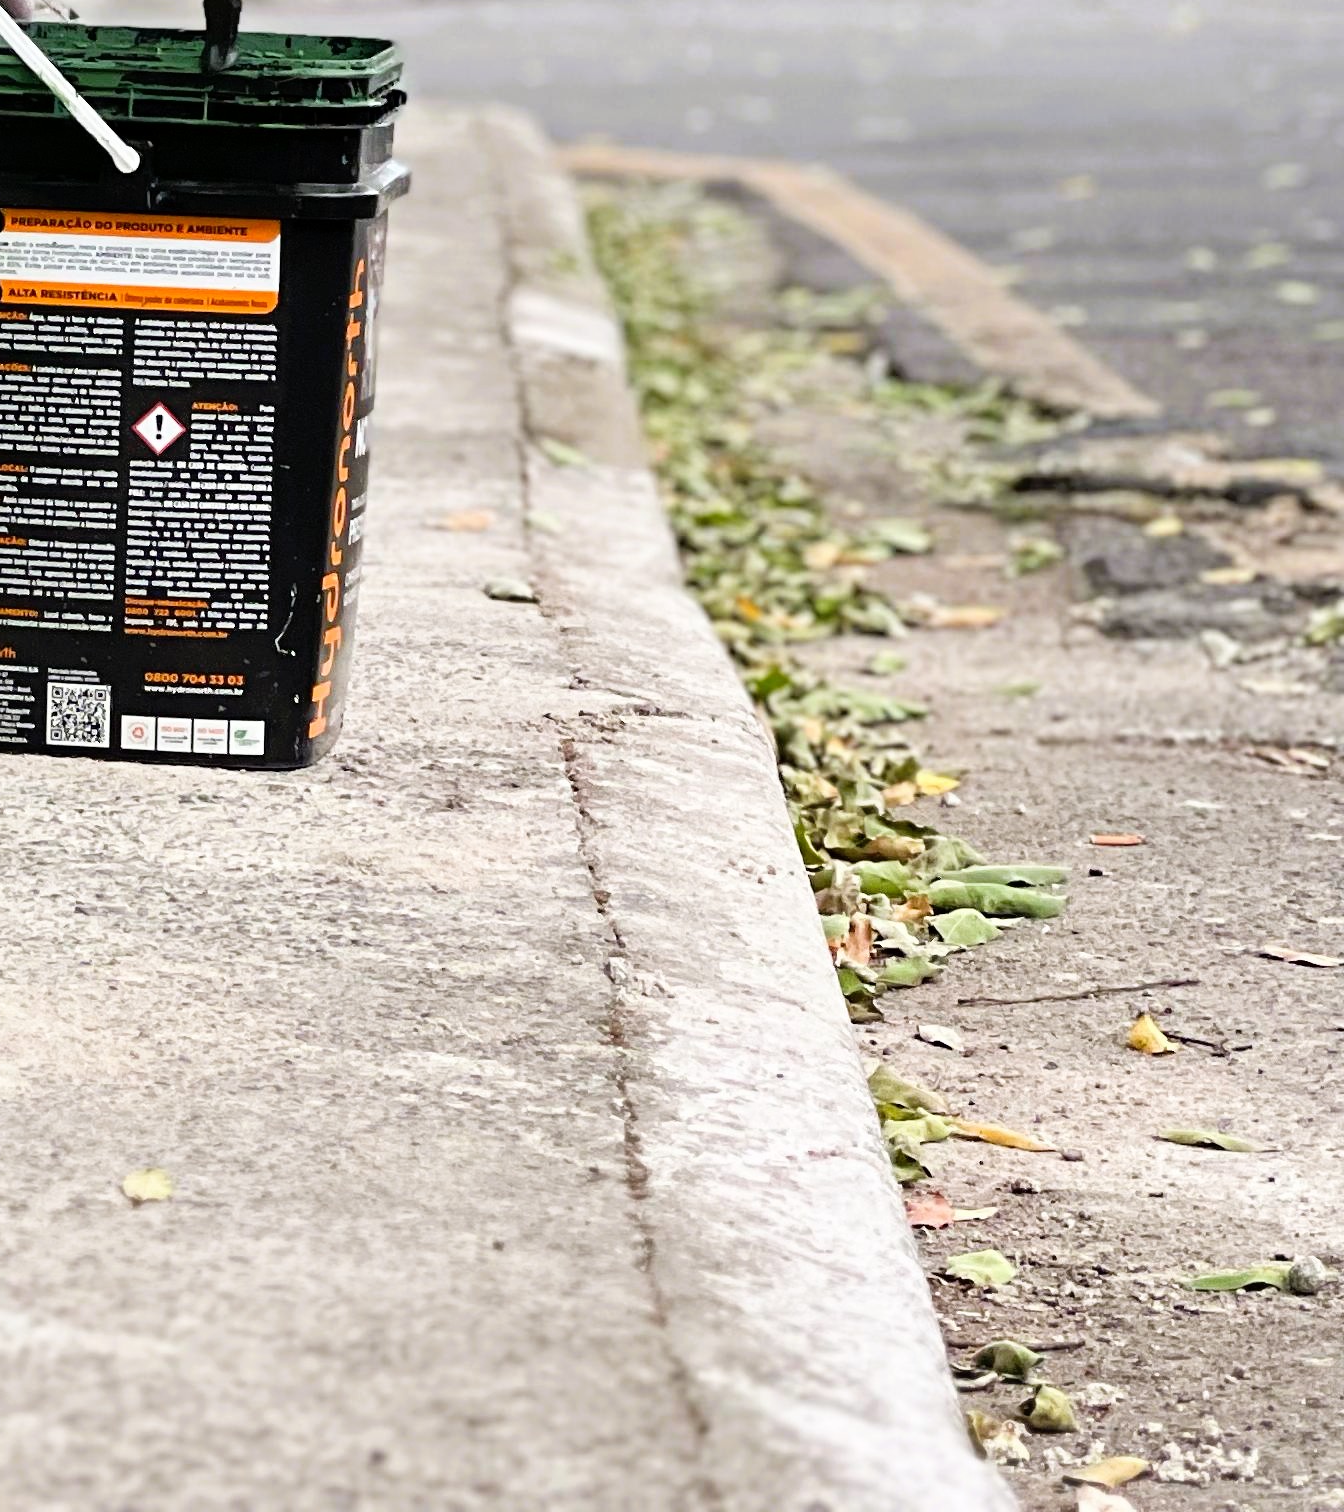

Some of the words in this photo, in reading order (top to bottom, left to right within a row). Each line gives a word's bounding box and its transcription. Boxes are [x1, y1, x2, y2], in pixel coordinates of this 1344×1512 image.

[10, 216, 92, 229] PREPARAÇÃO
[94, 221, 113, 230] DO
[115, 221, 174, 233] PRODUTO
[176, 224, 185, 233] E
[187, 224, 248, 236] AMBIENTE
[8, 288, 37, 298] ALTA
[40, 289, 118, 302] RESISTÊNCIA
[191, 401, 239, 412] ATENÇÃO:
[308, 257, 365, 739] Hydronorth
[144, 672, 179, 683] 0800
[182, 673, 207, 684] 704
[209, 674, 225, 685] 33
[227, 675, 244, 686] 03
[144, 685, 244, 696] www.hydronorth.com.br
